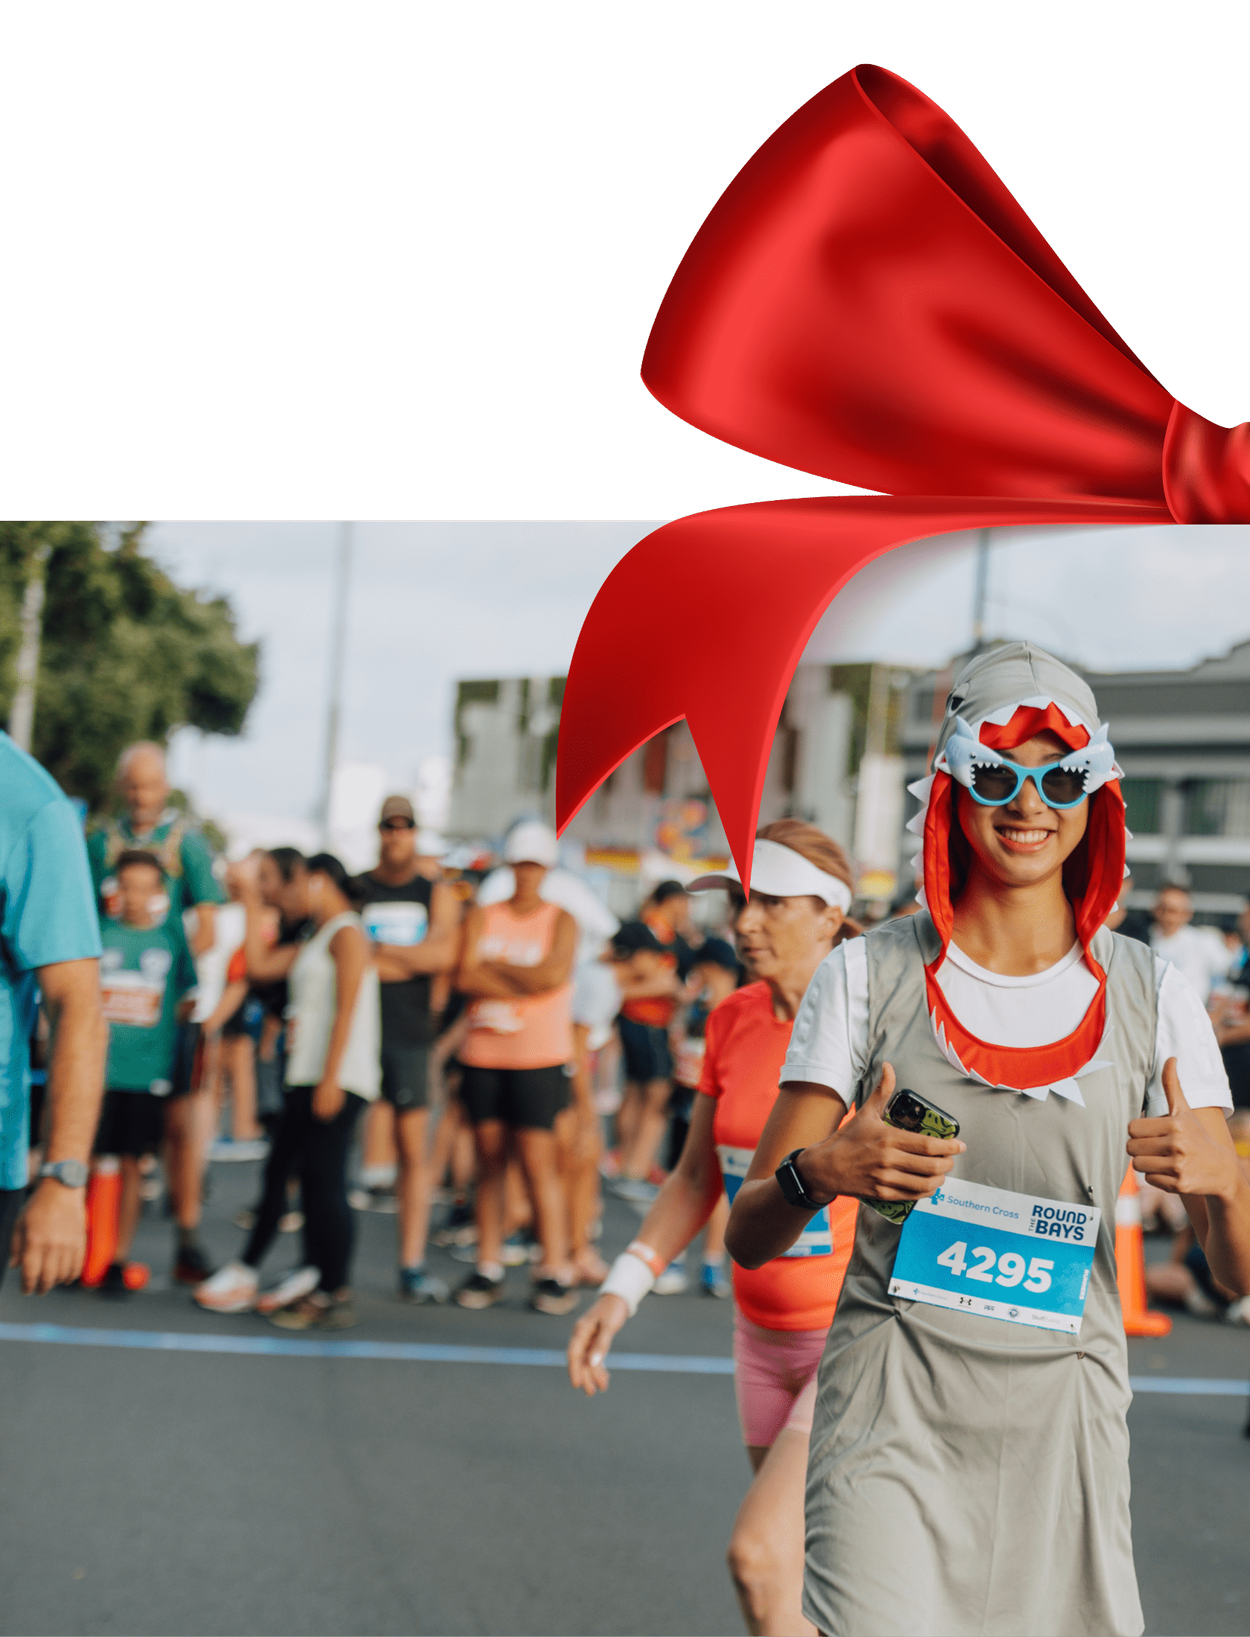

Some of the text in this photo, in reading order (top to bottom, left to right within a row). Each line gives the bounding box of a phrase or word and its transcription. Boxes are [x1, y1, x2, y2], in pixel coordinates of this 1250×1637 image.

[947, 1195, 1019, 1219] Southern Cross
[1032, 1204, 1087, 1225] ROUND
[1035, 1219, 1085, 1241] BAYS
[936, 1240, 1054, 1293] 4295
